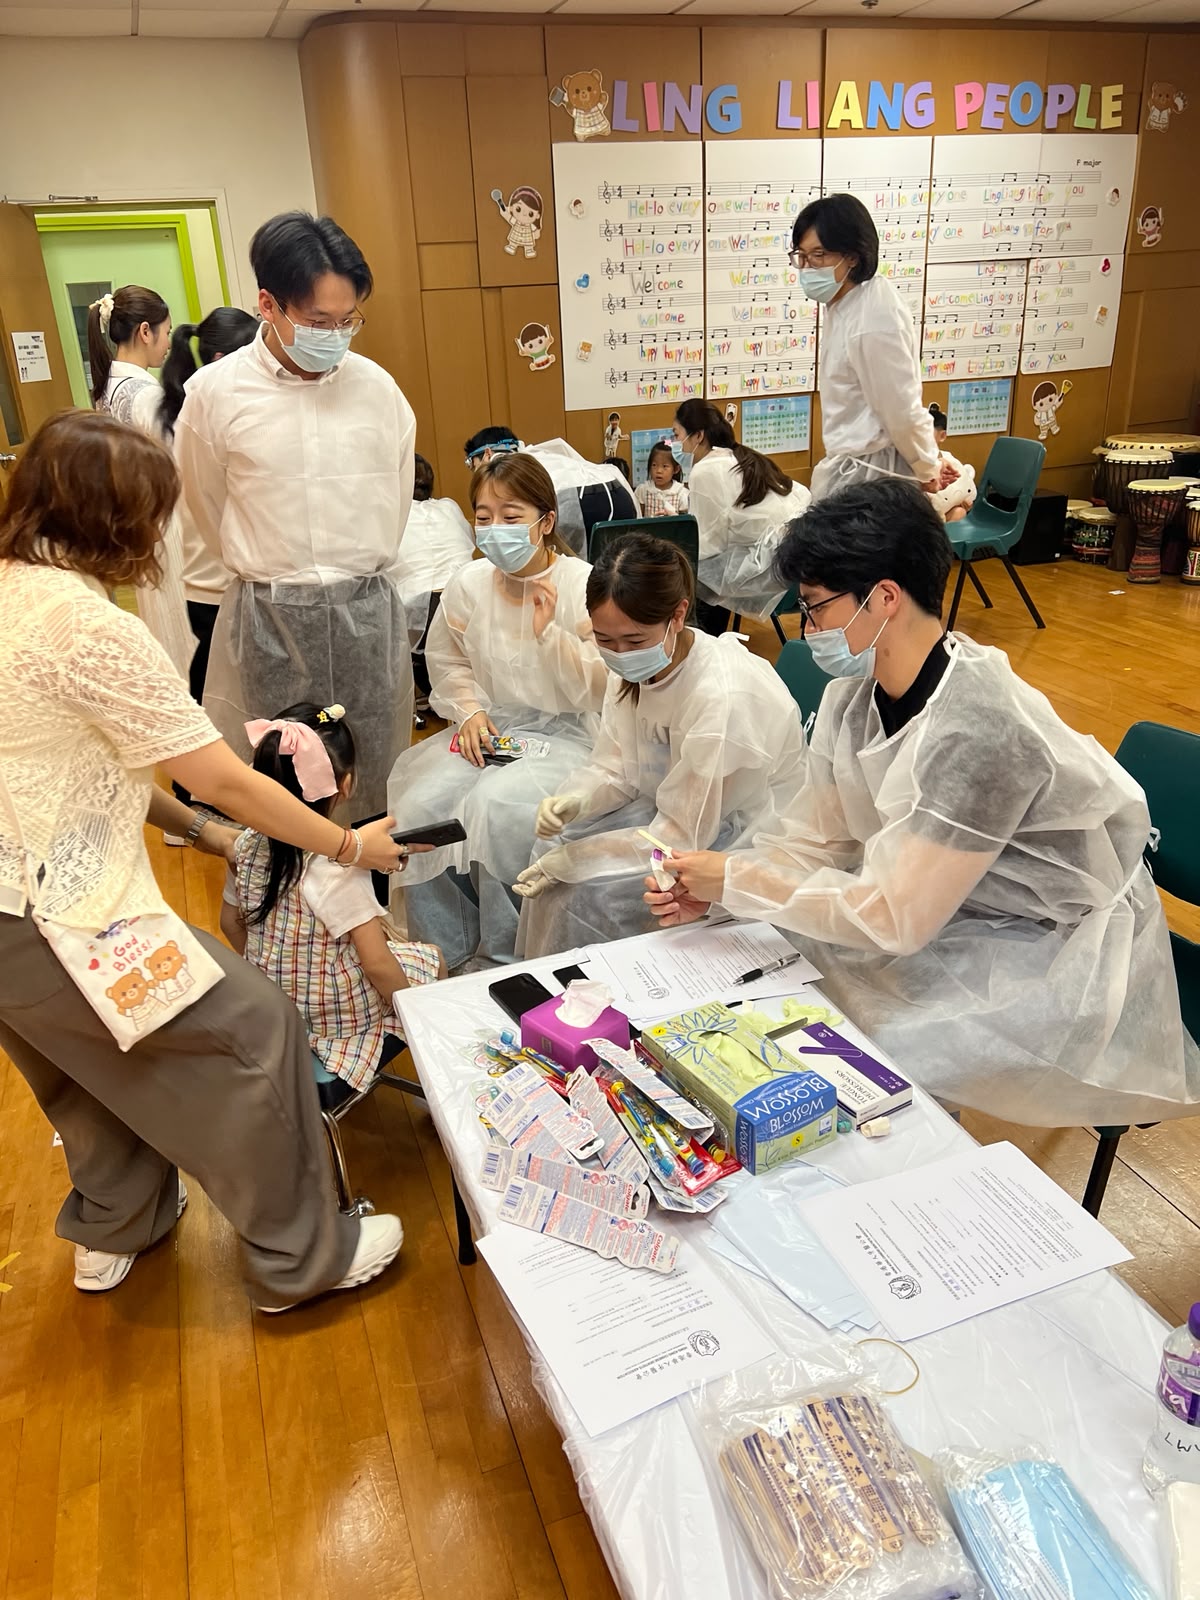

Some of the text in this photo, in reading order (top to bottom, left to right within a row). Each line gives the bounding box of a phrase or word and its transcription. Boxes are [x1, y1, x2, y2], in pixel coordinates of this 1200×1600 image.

[612, 80, 1123, 134] LING LIANG PEOPLE
[1083, 159, 1102, 169] major
[668, 200, 701, 215] every
[668, 239, 701, 253] every
[944, 227, 963, 238] one
[782, 268, 796, 284] to
[783, 302, 796, 319] to
[112, 939, 152, 972] Bless!
[114, 934, 138, 957] God
[834, 1068, 875, 1101] DEPRESSORS
[839, 1081, 867, 1105] TONGUE
[744, 1076, 828, 1121] BLOSSOM
[770, 1097, 825, 1133] BLOSSOM
[795, 1136, 801, 1145] S
[624, 1183, 634, 1213] Colgate
[651, 1234, 663, 1264] Colgate
